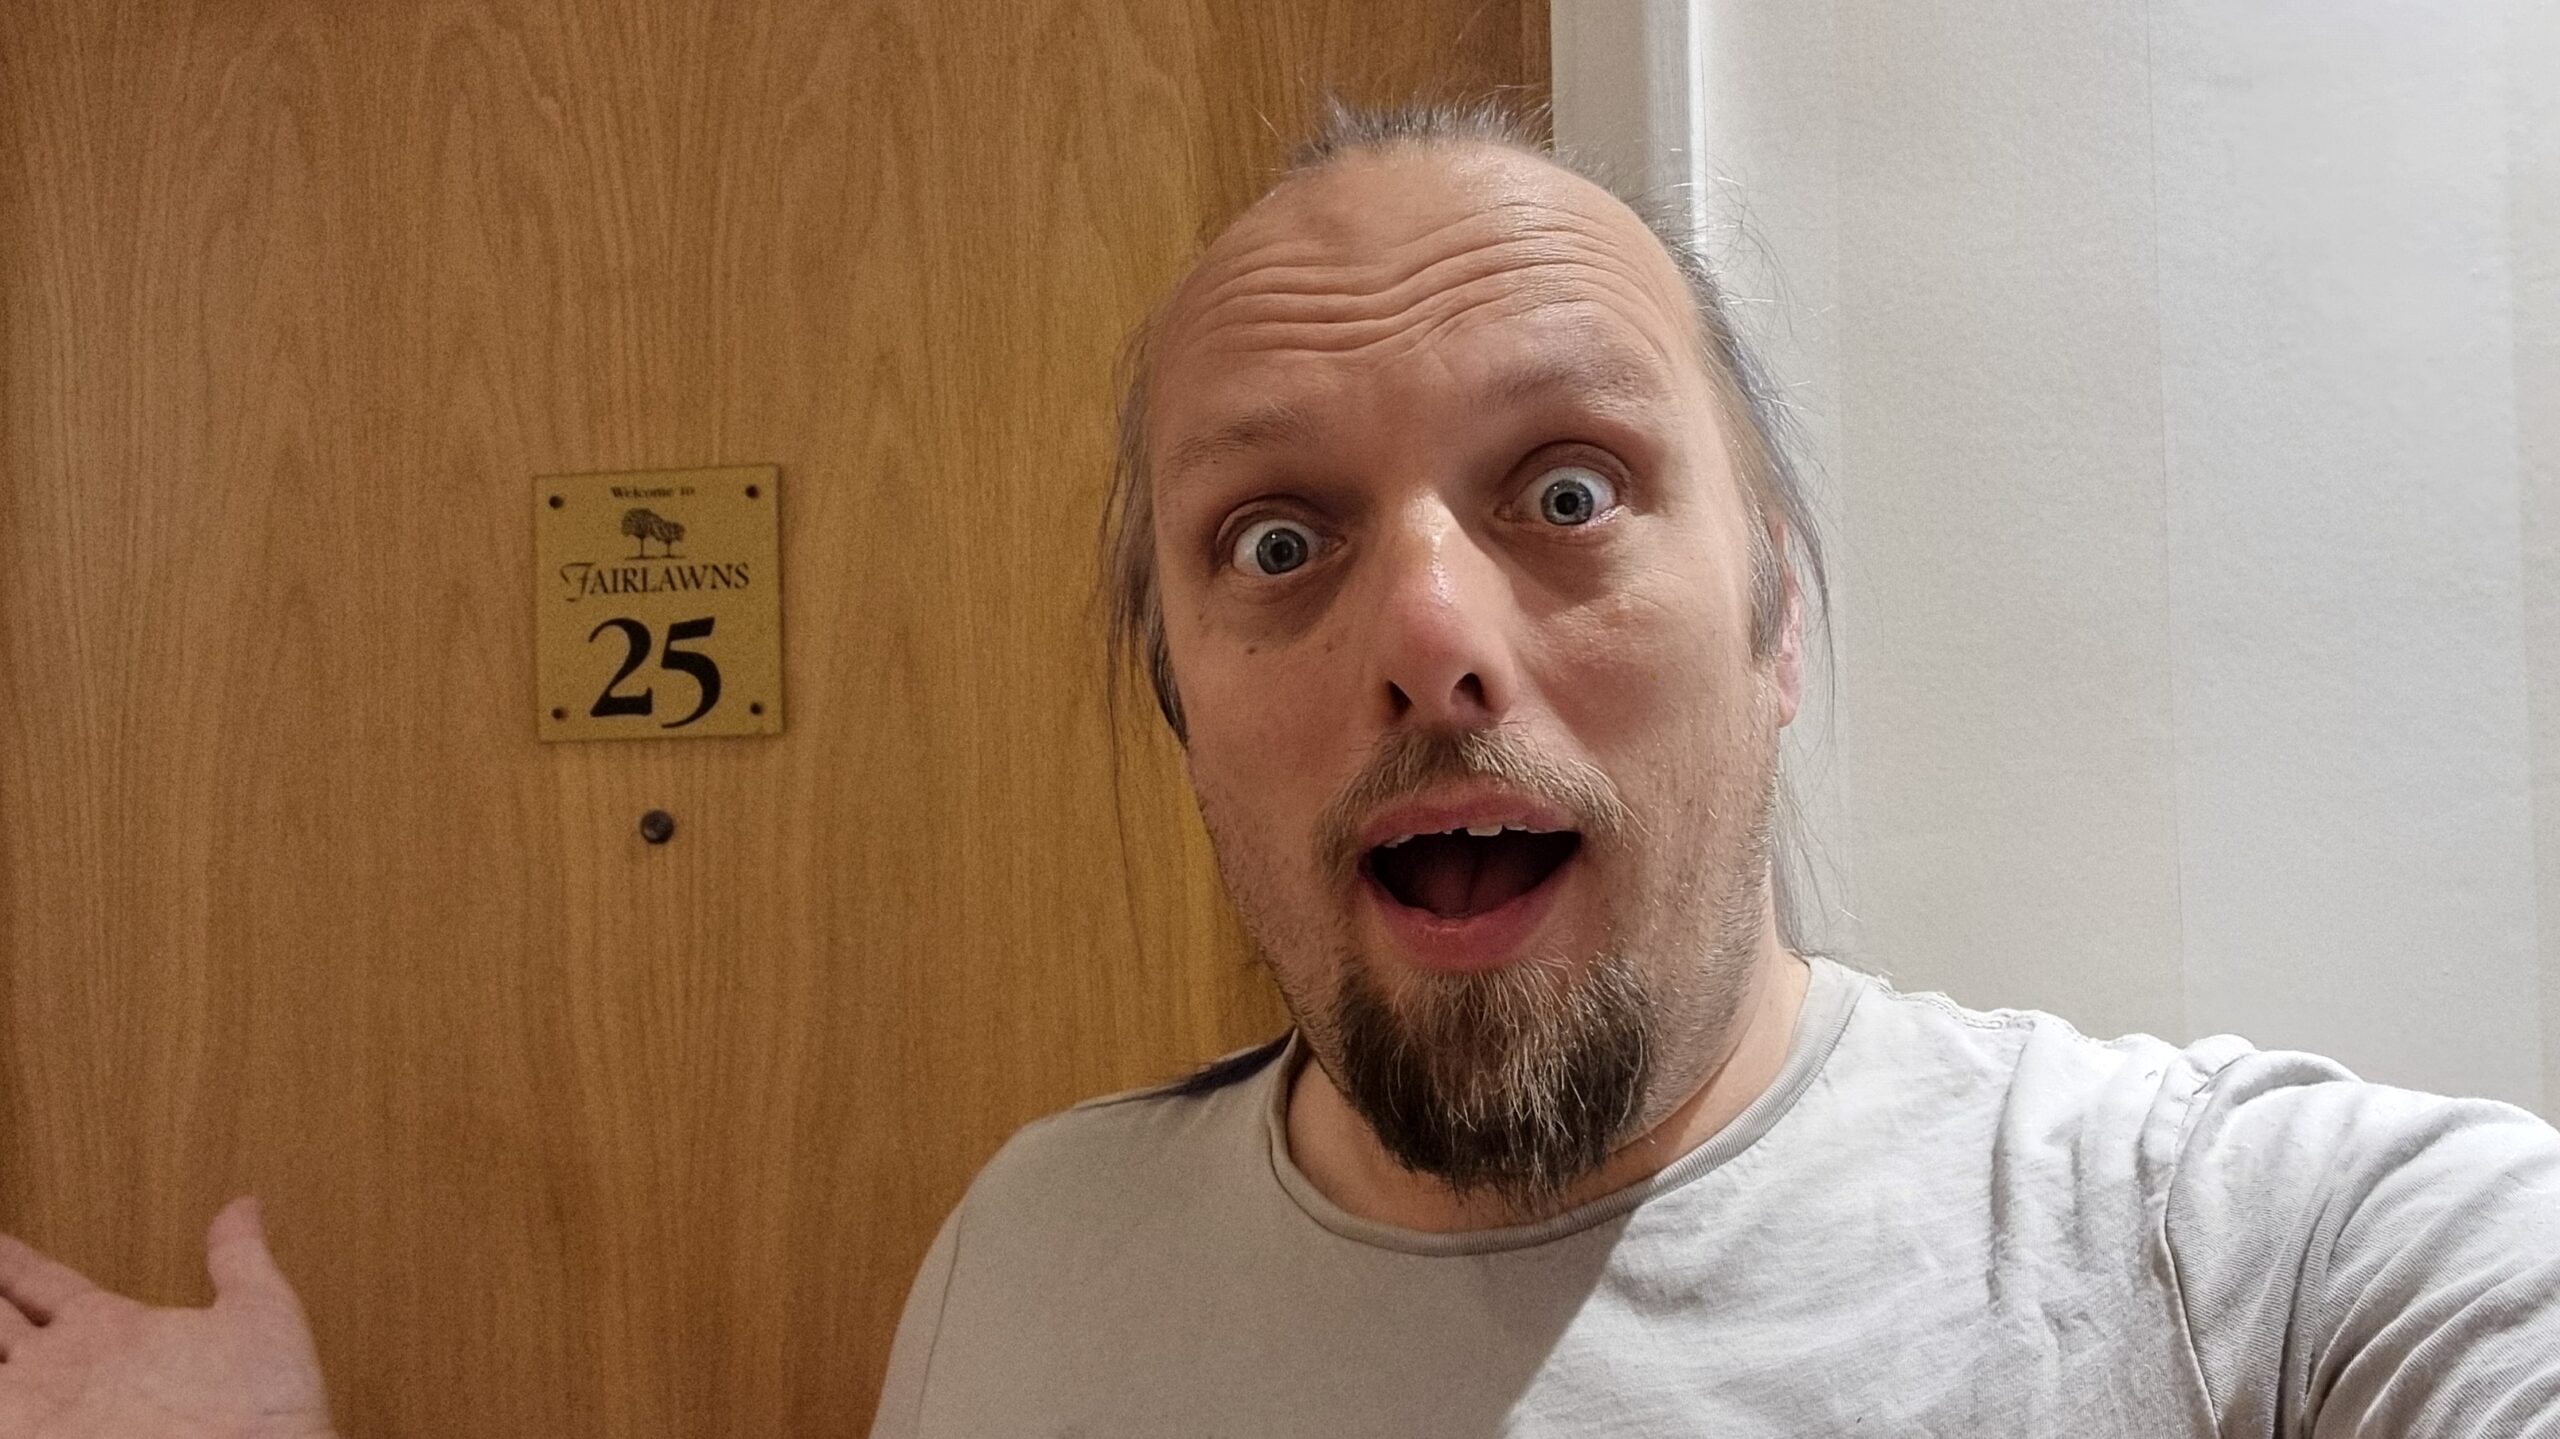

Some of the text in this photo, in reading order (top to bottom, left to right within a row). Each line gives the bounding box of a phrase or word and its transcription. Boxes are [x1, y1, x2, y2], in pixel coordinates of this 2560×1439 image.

[610, 485, 696, 499] Welcome to
[559, 562, 750, 602] FAIRLAWNS
[588, 616, 722, 729] 25
